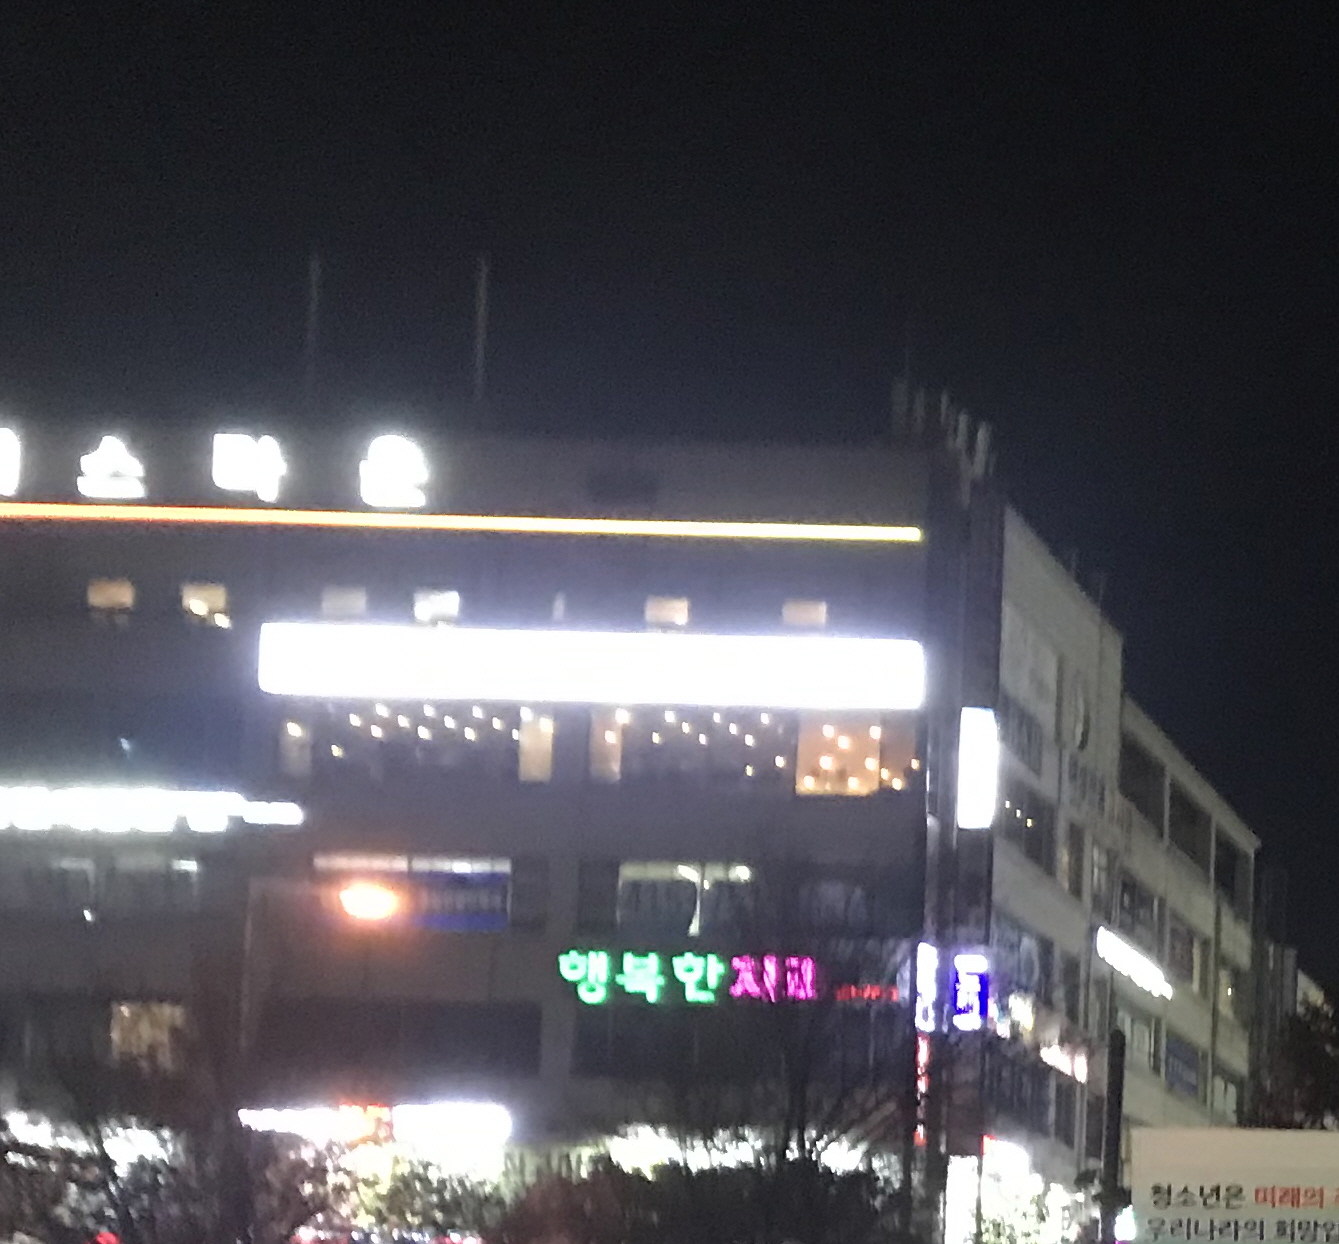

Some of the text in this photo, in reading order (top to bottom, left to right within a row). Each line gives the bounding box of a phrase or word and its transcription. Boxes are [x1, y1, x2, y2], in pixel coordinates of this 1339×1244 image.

[1151, 1183, 1244, 1210] 청소년은
[1254, 1184, 1325, 1210] 미래의
[1146, 1216, 1265, 1243] 우리나라의
